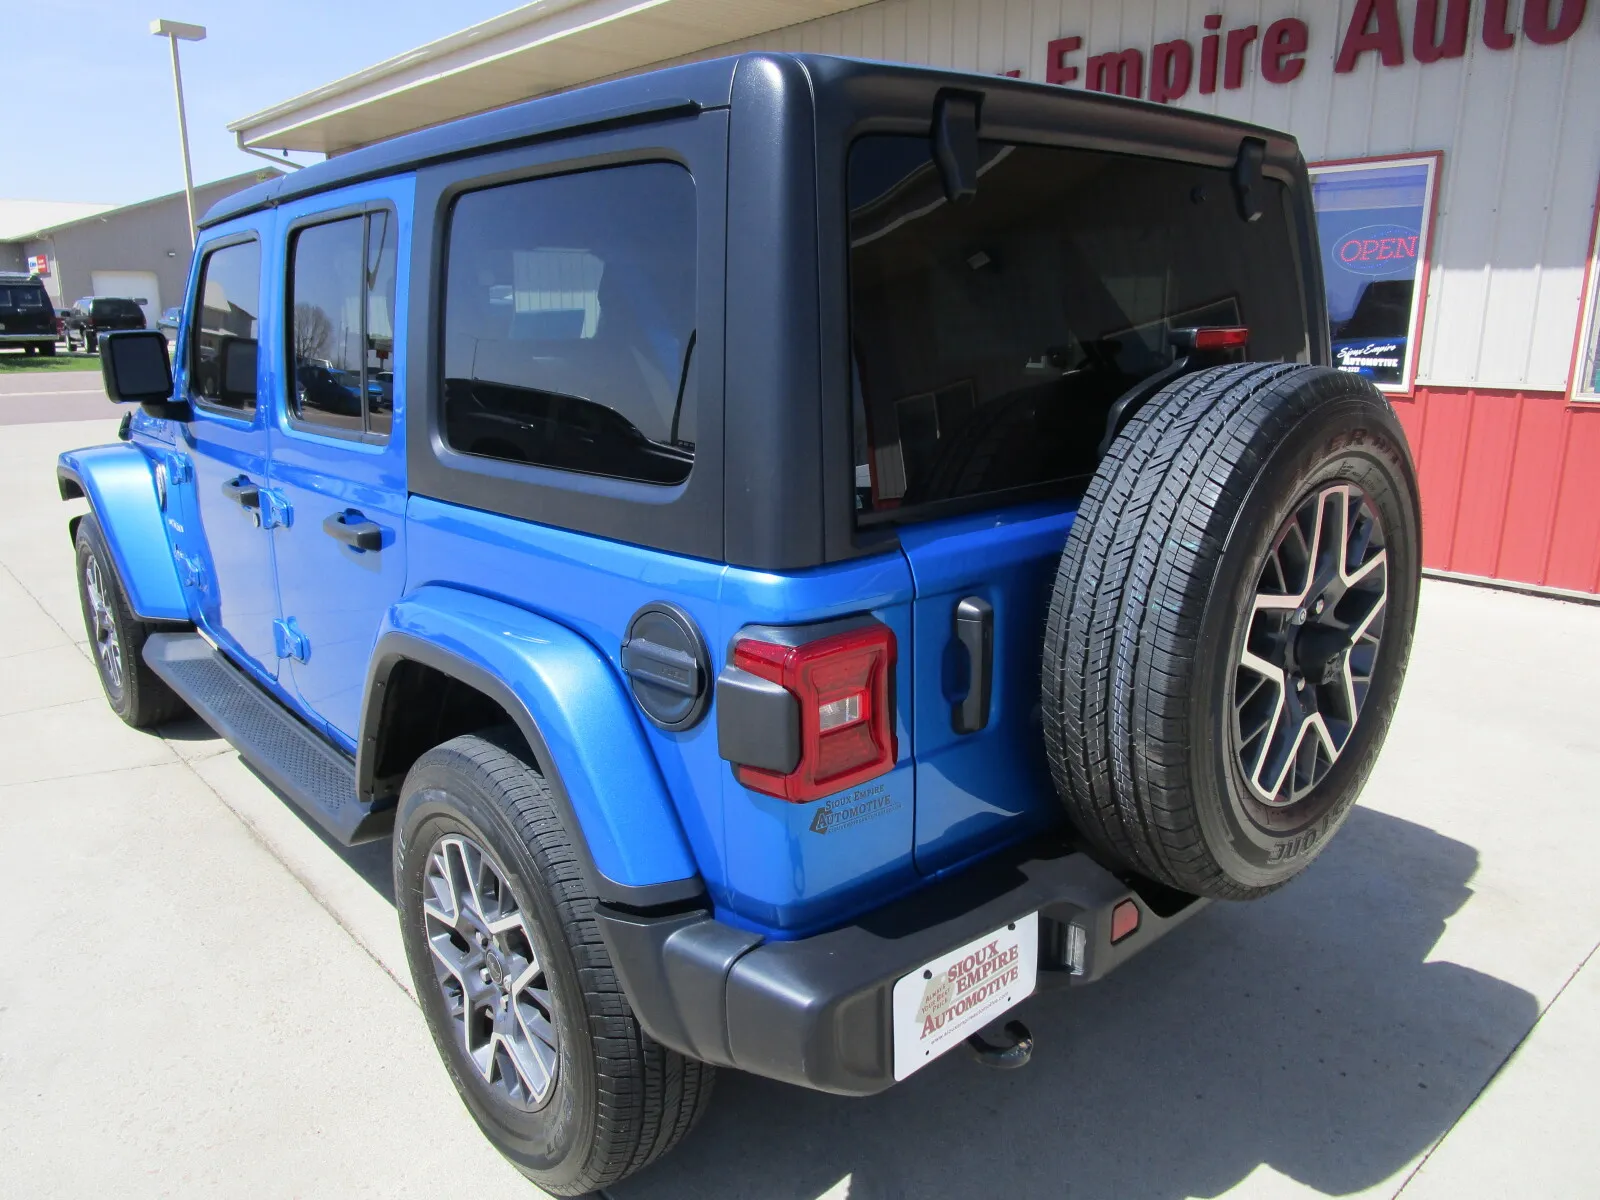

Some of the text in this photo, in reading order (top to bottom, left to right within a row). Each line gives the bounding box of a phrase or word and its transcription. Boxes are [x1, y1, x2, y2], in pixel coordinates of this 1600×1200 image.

[1046, 0, 1587, 104] Empire Auto
[1340, 236, 1419, 262] OPEN
[1337, 343, 1397, 358] Sioux Empire
[1342, 354, 1398, 367] AUTOMOTIVE
[816, 794, 891, 829] AUTOMOTIVE
[825, 784, 884, 811] SIOUX EMPIRE
[947, 939, 1000, 983] SIOUX
[956, 944, 1019, 995] EMPIRE
[920, 966, 1019, 1040] AUTOMOTIVE
